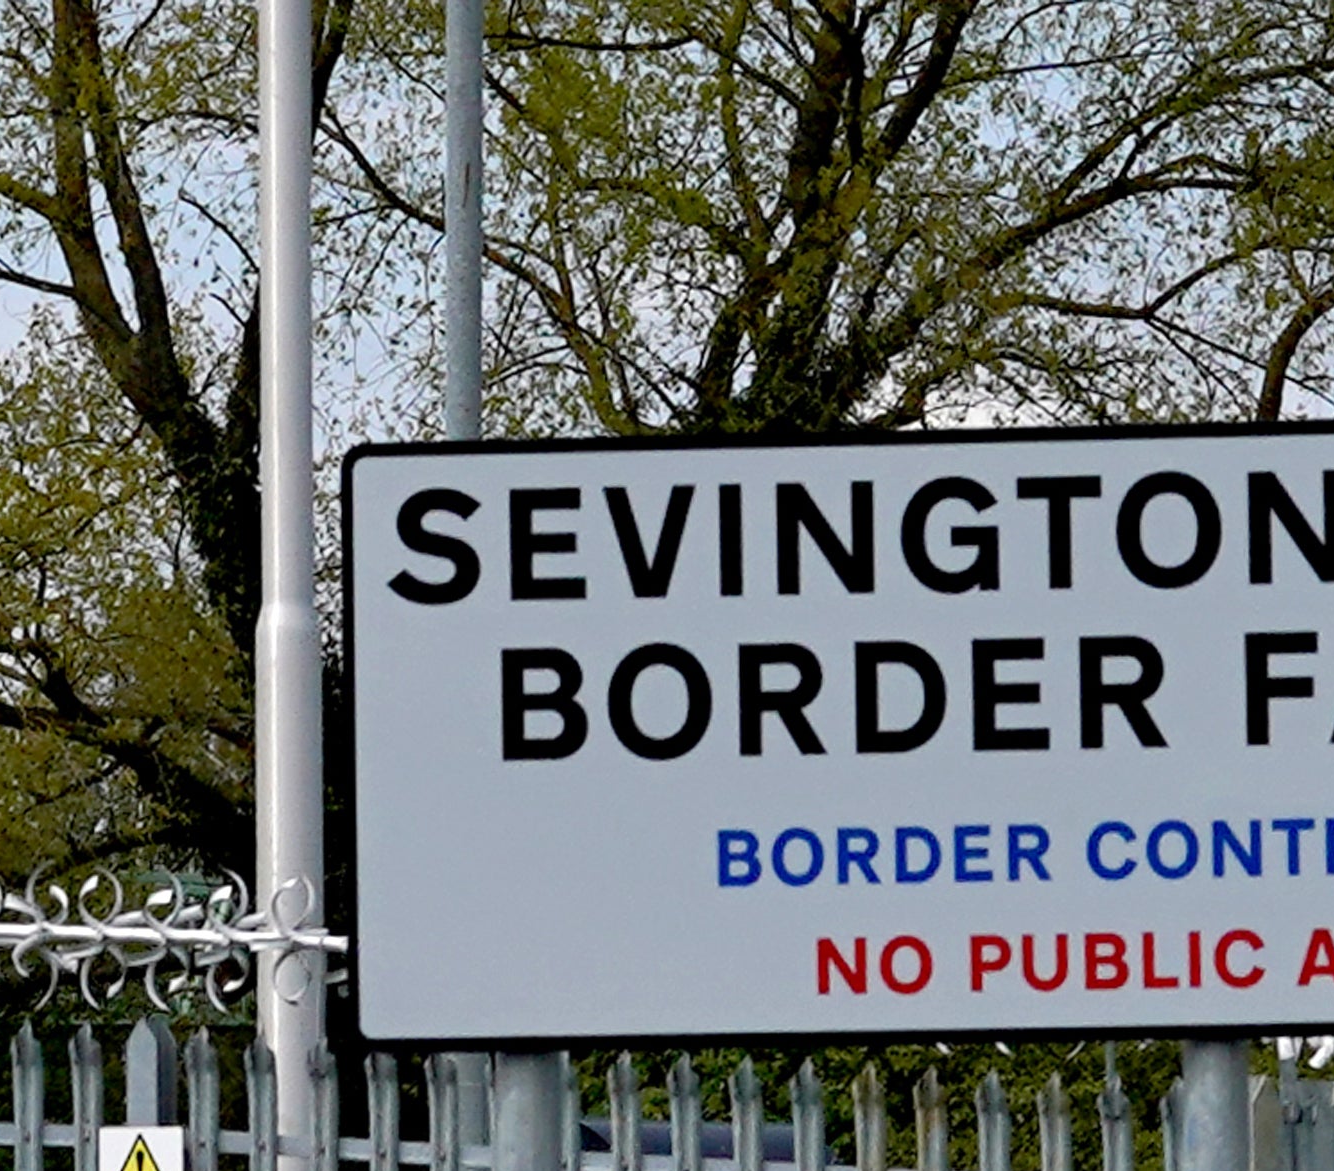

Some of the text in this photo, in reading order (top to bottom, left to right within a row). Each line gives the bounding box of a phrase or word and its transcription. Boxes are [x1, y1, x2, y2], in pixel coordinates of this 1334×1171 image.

[500, 634, 1169, 762] BORDER
[716, 823, 1052, 888] BORDER
[816, 934, 933, 995] NO
[969, 927, 1266, 993] PUBLIC
